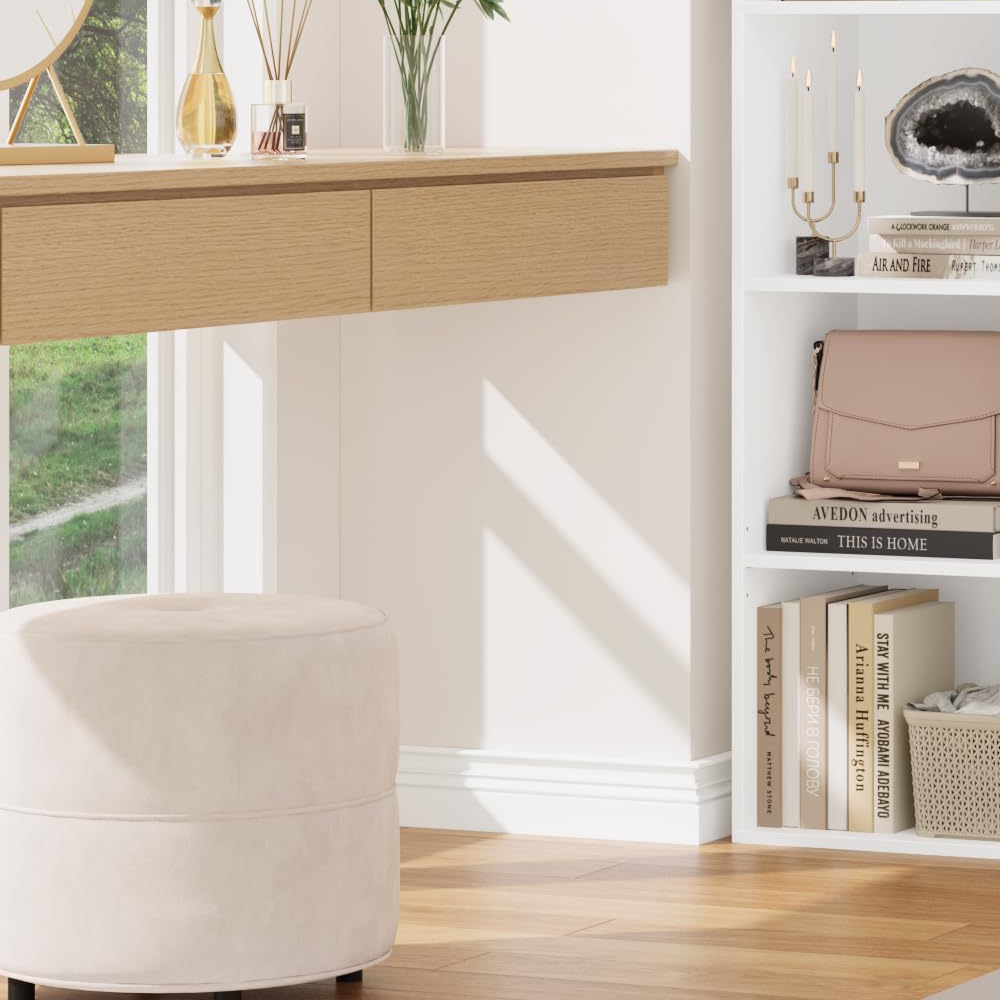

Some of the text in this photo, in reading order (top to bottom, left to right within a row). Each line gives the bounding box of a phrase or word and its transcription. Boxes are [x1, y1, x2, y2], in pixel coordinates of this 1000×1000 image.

[896, 223, 928, 232] CLOCKWORK
[928, 223, 950, 231] ORANGE
[969, 239, 993, 252] Harper
[812, 506, 938, 528] AVEDON advertising
[780, 536, 828, 545] NATALIE WALTON
[837, 534, 928, 551] THIS IS HOME
[763, 625, 775, 653] The
[762, 657, 777, 686] body
[807, 666, 819, 683] НЕ
[807, 687, 819, 724] БЕРИ
[851, 643, 869, 792] Arianna Huffington
[877, 633, 890, 819] STAY WITH ME AYOBAMI ADEBAYO
[807, 728, 819, 736] В
[807, 740, 819, 797] ГОЛОВУ
